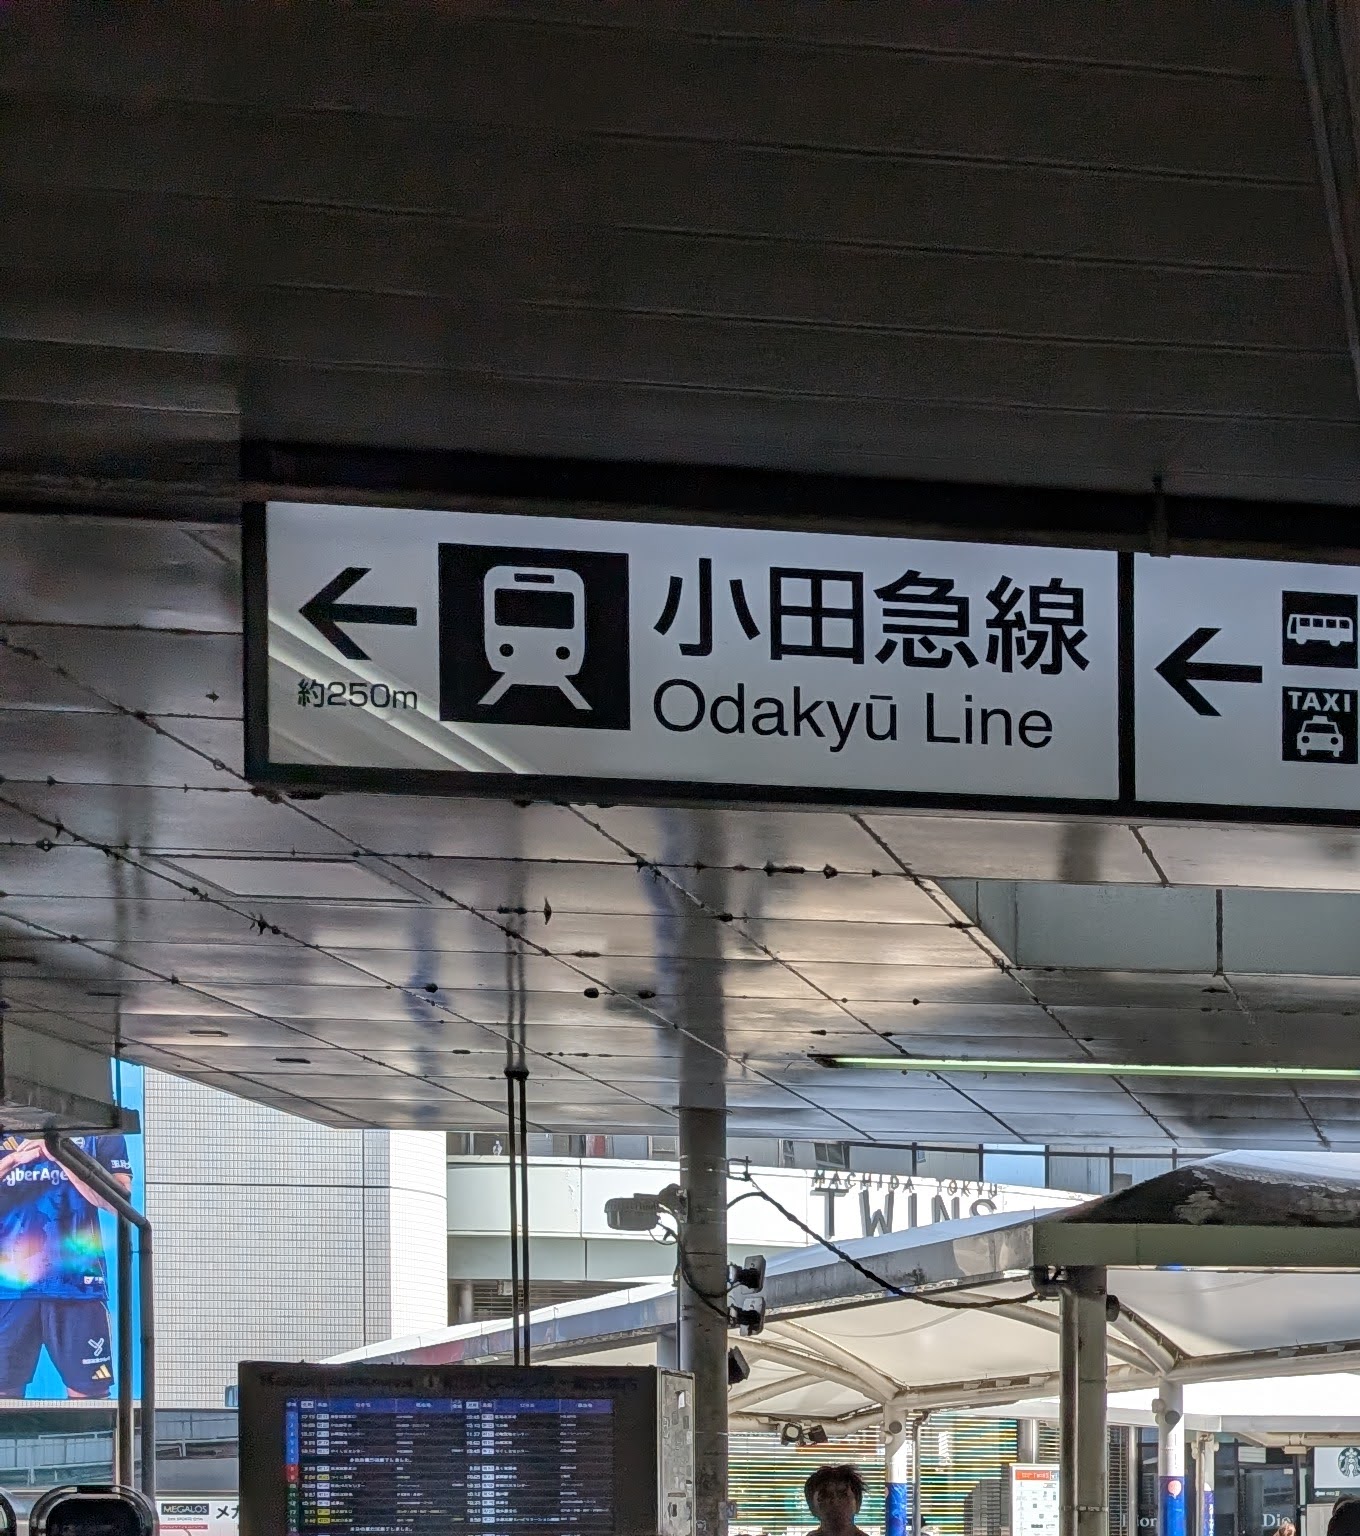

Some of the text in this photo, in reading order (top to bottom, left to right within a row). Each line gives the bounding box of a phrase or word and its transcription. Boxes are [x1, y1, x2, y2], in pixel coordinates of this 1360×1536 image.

[653, 557, 1090, 676] 小田急線
[296, 678, 418, 711] 約250m
[1288, 691, 1352, 714] TAXI
[653, 679, 1054, 753] Odakyū Line
[2, 1167, 68, 1186] yberAge
[812, 1169, 999, 1199] MACHIDA TOKYU
[163, 1505, 207, 1514] MEGALOS
[1262, 1513, 1293, 1527] Dio
